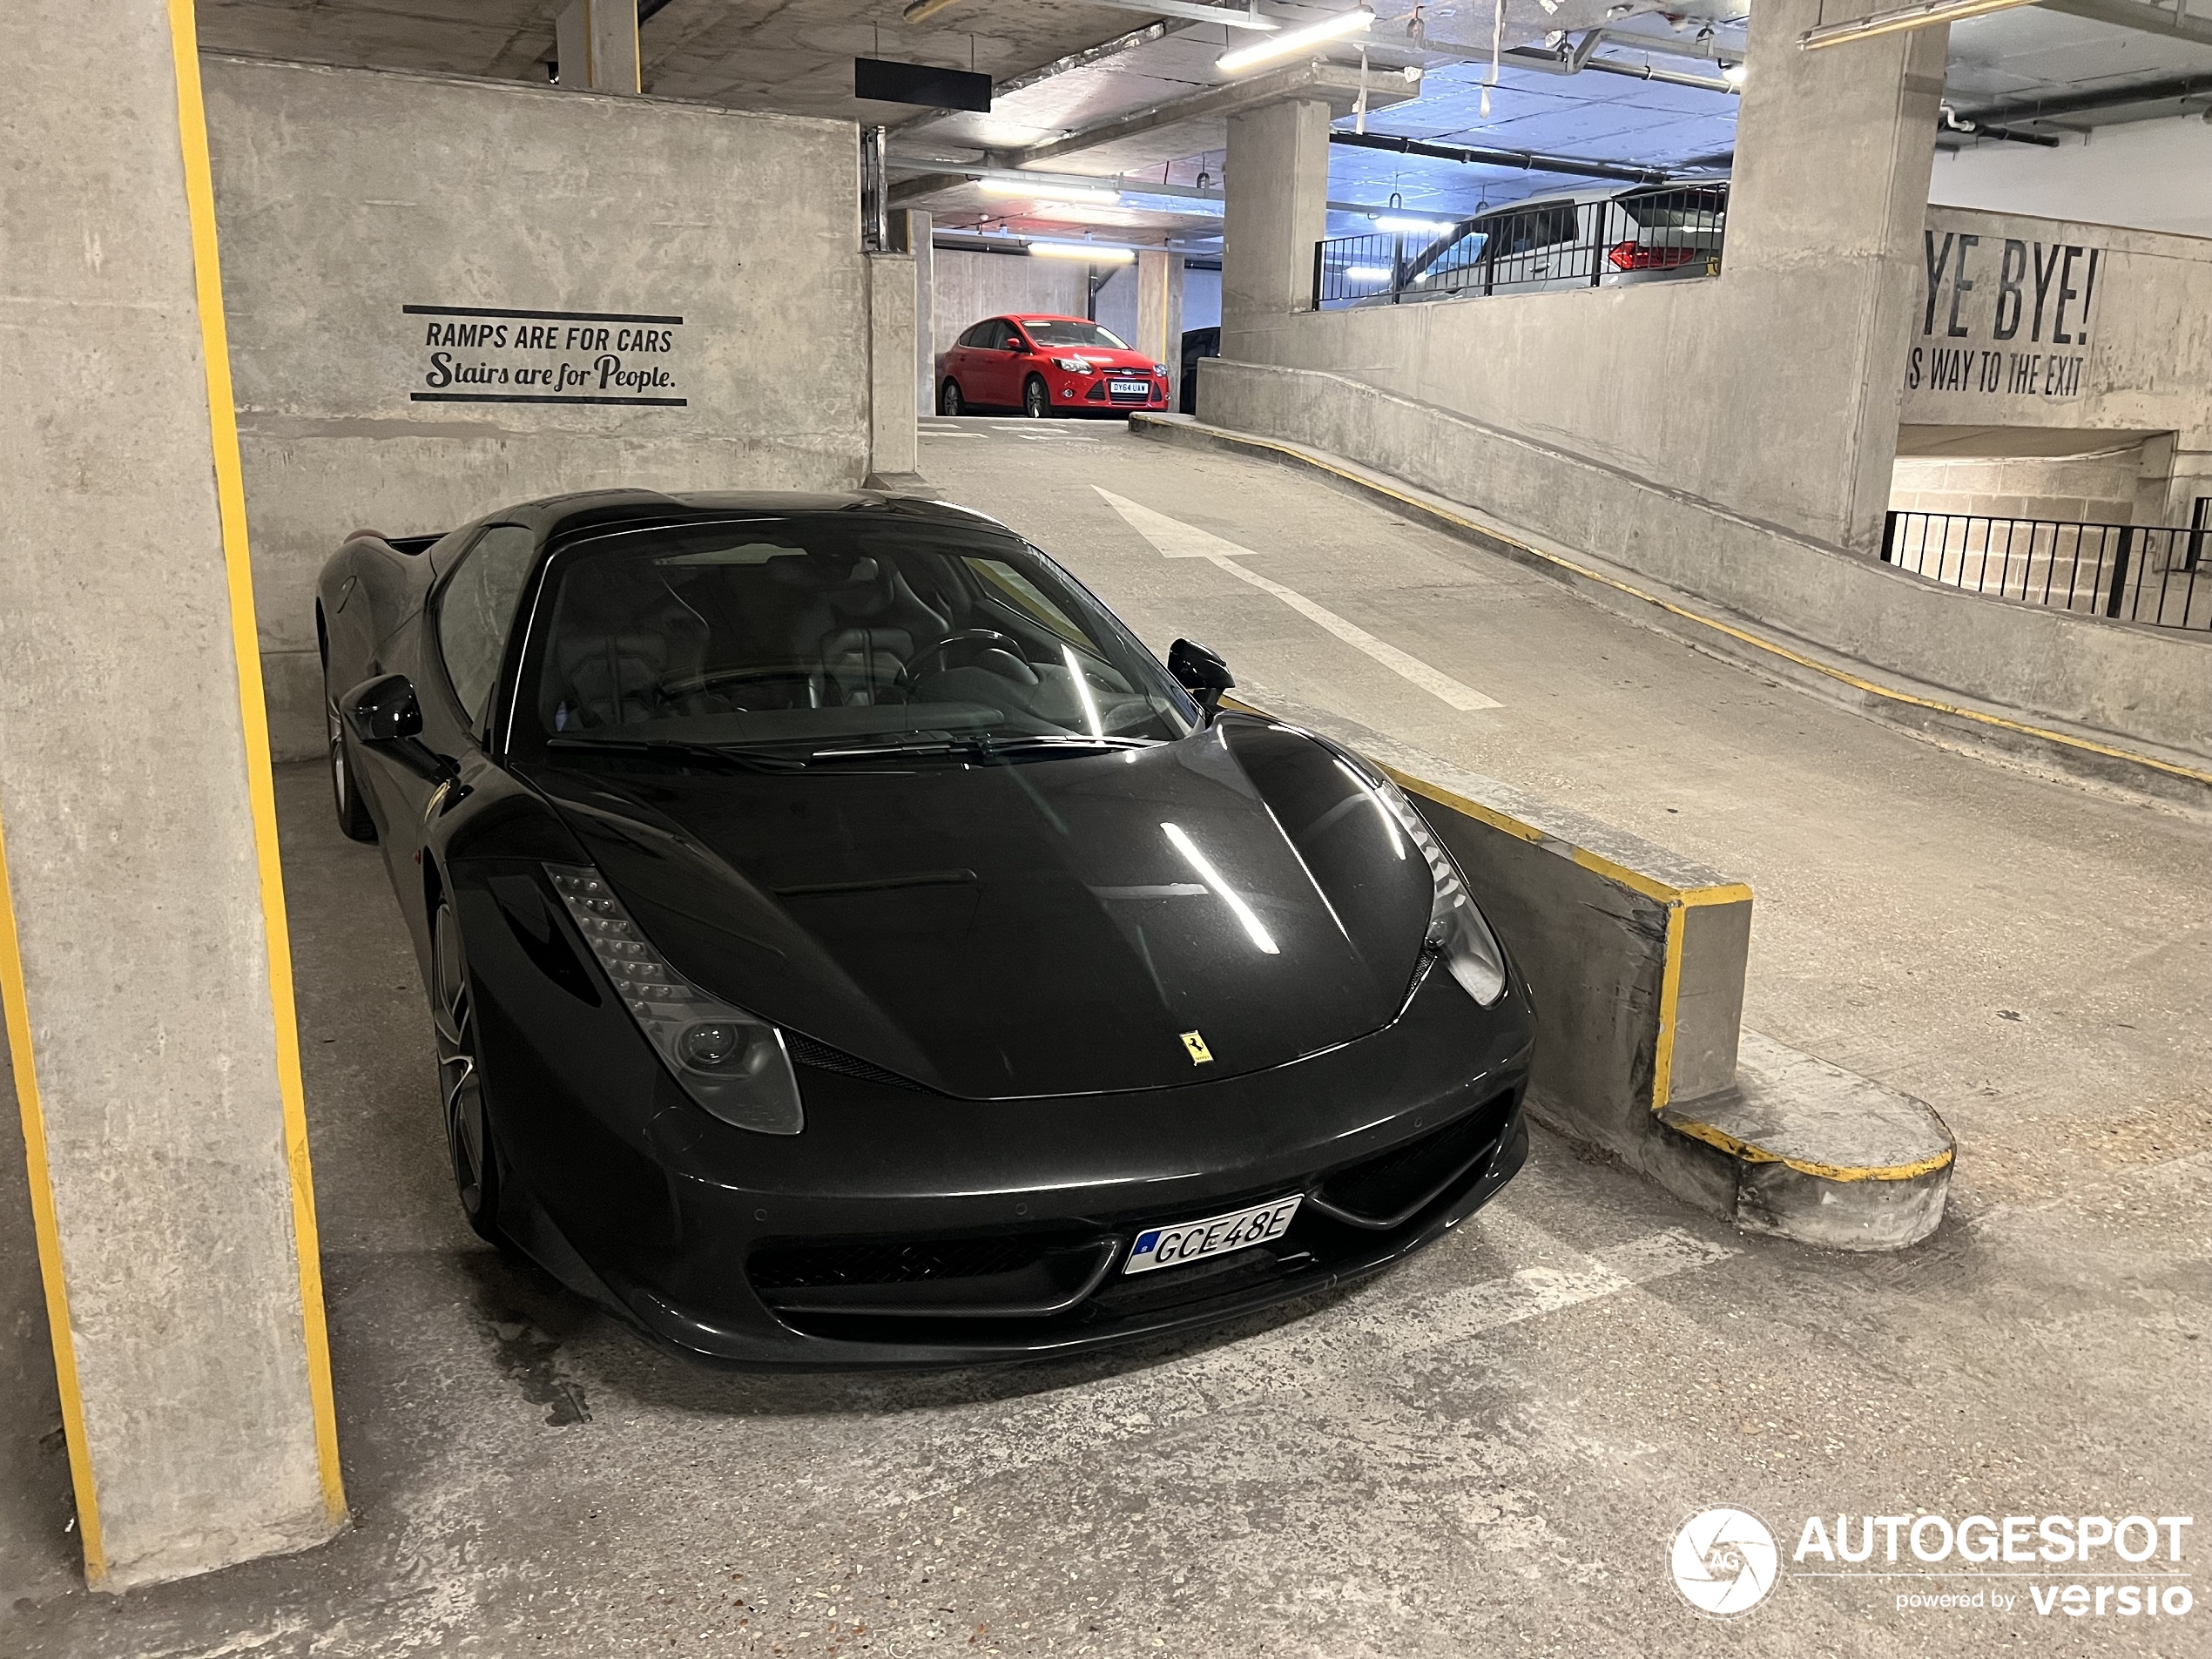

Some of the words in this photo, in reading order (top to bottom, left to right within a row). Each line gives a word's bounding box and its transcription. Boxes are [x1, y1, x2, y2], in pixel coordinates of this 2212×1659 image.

[1924, 230, 1979, 337] YE
[1993, 239, 2099, 345] BYE!
[426, 323, 508, 347] RAMPS
[514, 326, 559, 349] ARE
[566, 327, 610, 350] FOR
[617, 329, 672, 352] CARS
[426, 352, 509, 388] Stairs
[514, 368, 553, 386] are
[554, 363, 590, 392] for
[594, 354, 676, 393] People.
[1931, 348, 1974, 391] WAY
[1979, 351, 2001, 392] TO
[2007, 353, 2041, 395] THE
[2045, 354, 2083, 395] EXIT
